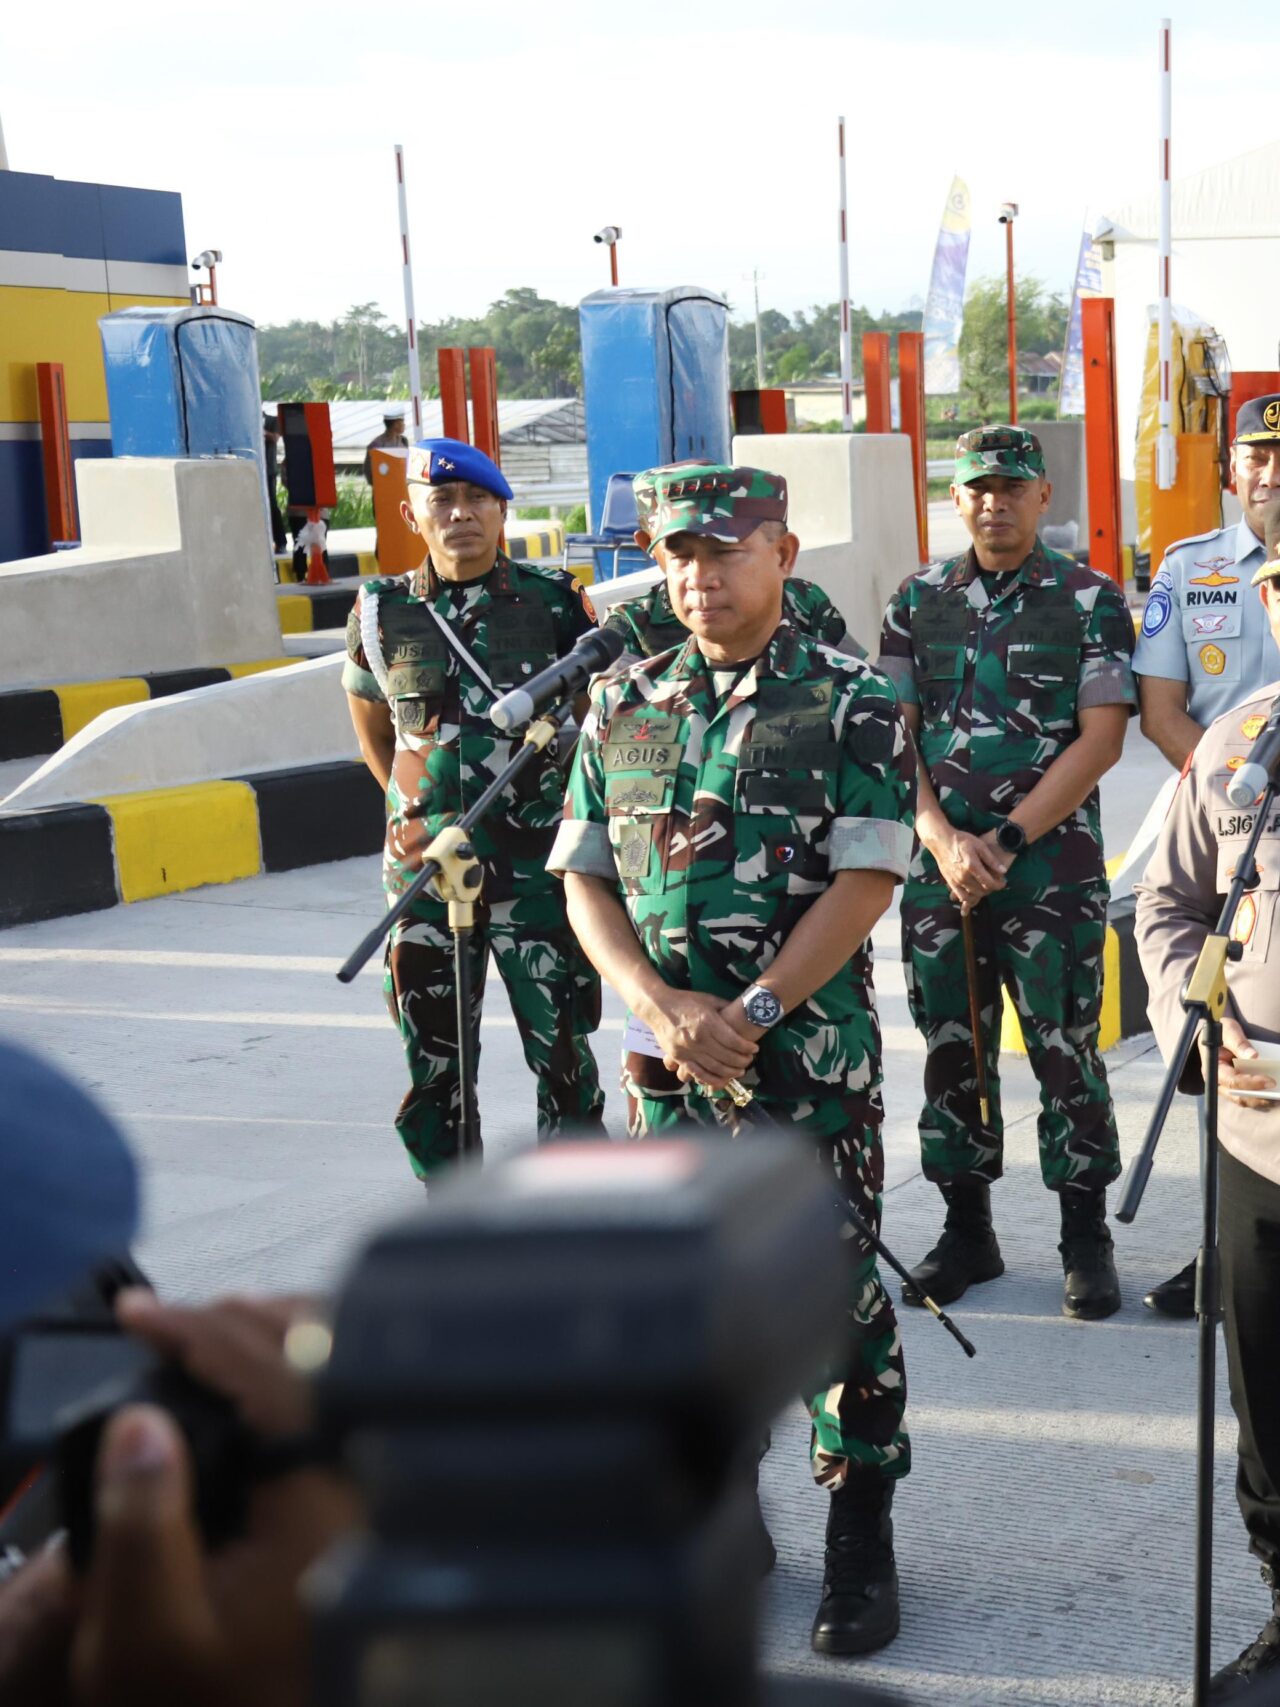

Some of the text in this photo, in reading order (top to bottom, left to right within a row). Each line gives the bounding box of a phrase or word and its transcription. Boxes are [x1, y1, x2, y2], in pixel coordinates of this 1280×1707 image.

[1186, 590, 1238, 606] RIVAN
[612, 747, 670, 768] AGUS
[746, 745, 785, 765] TNI
